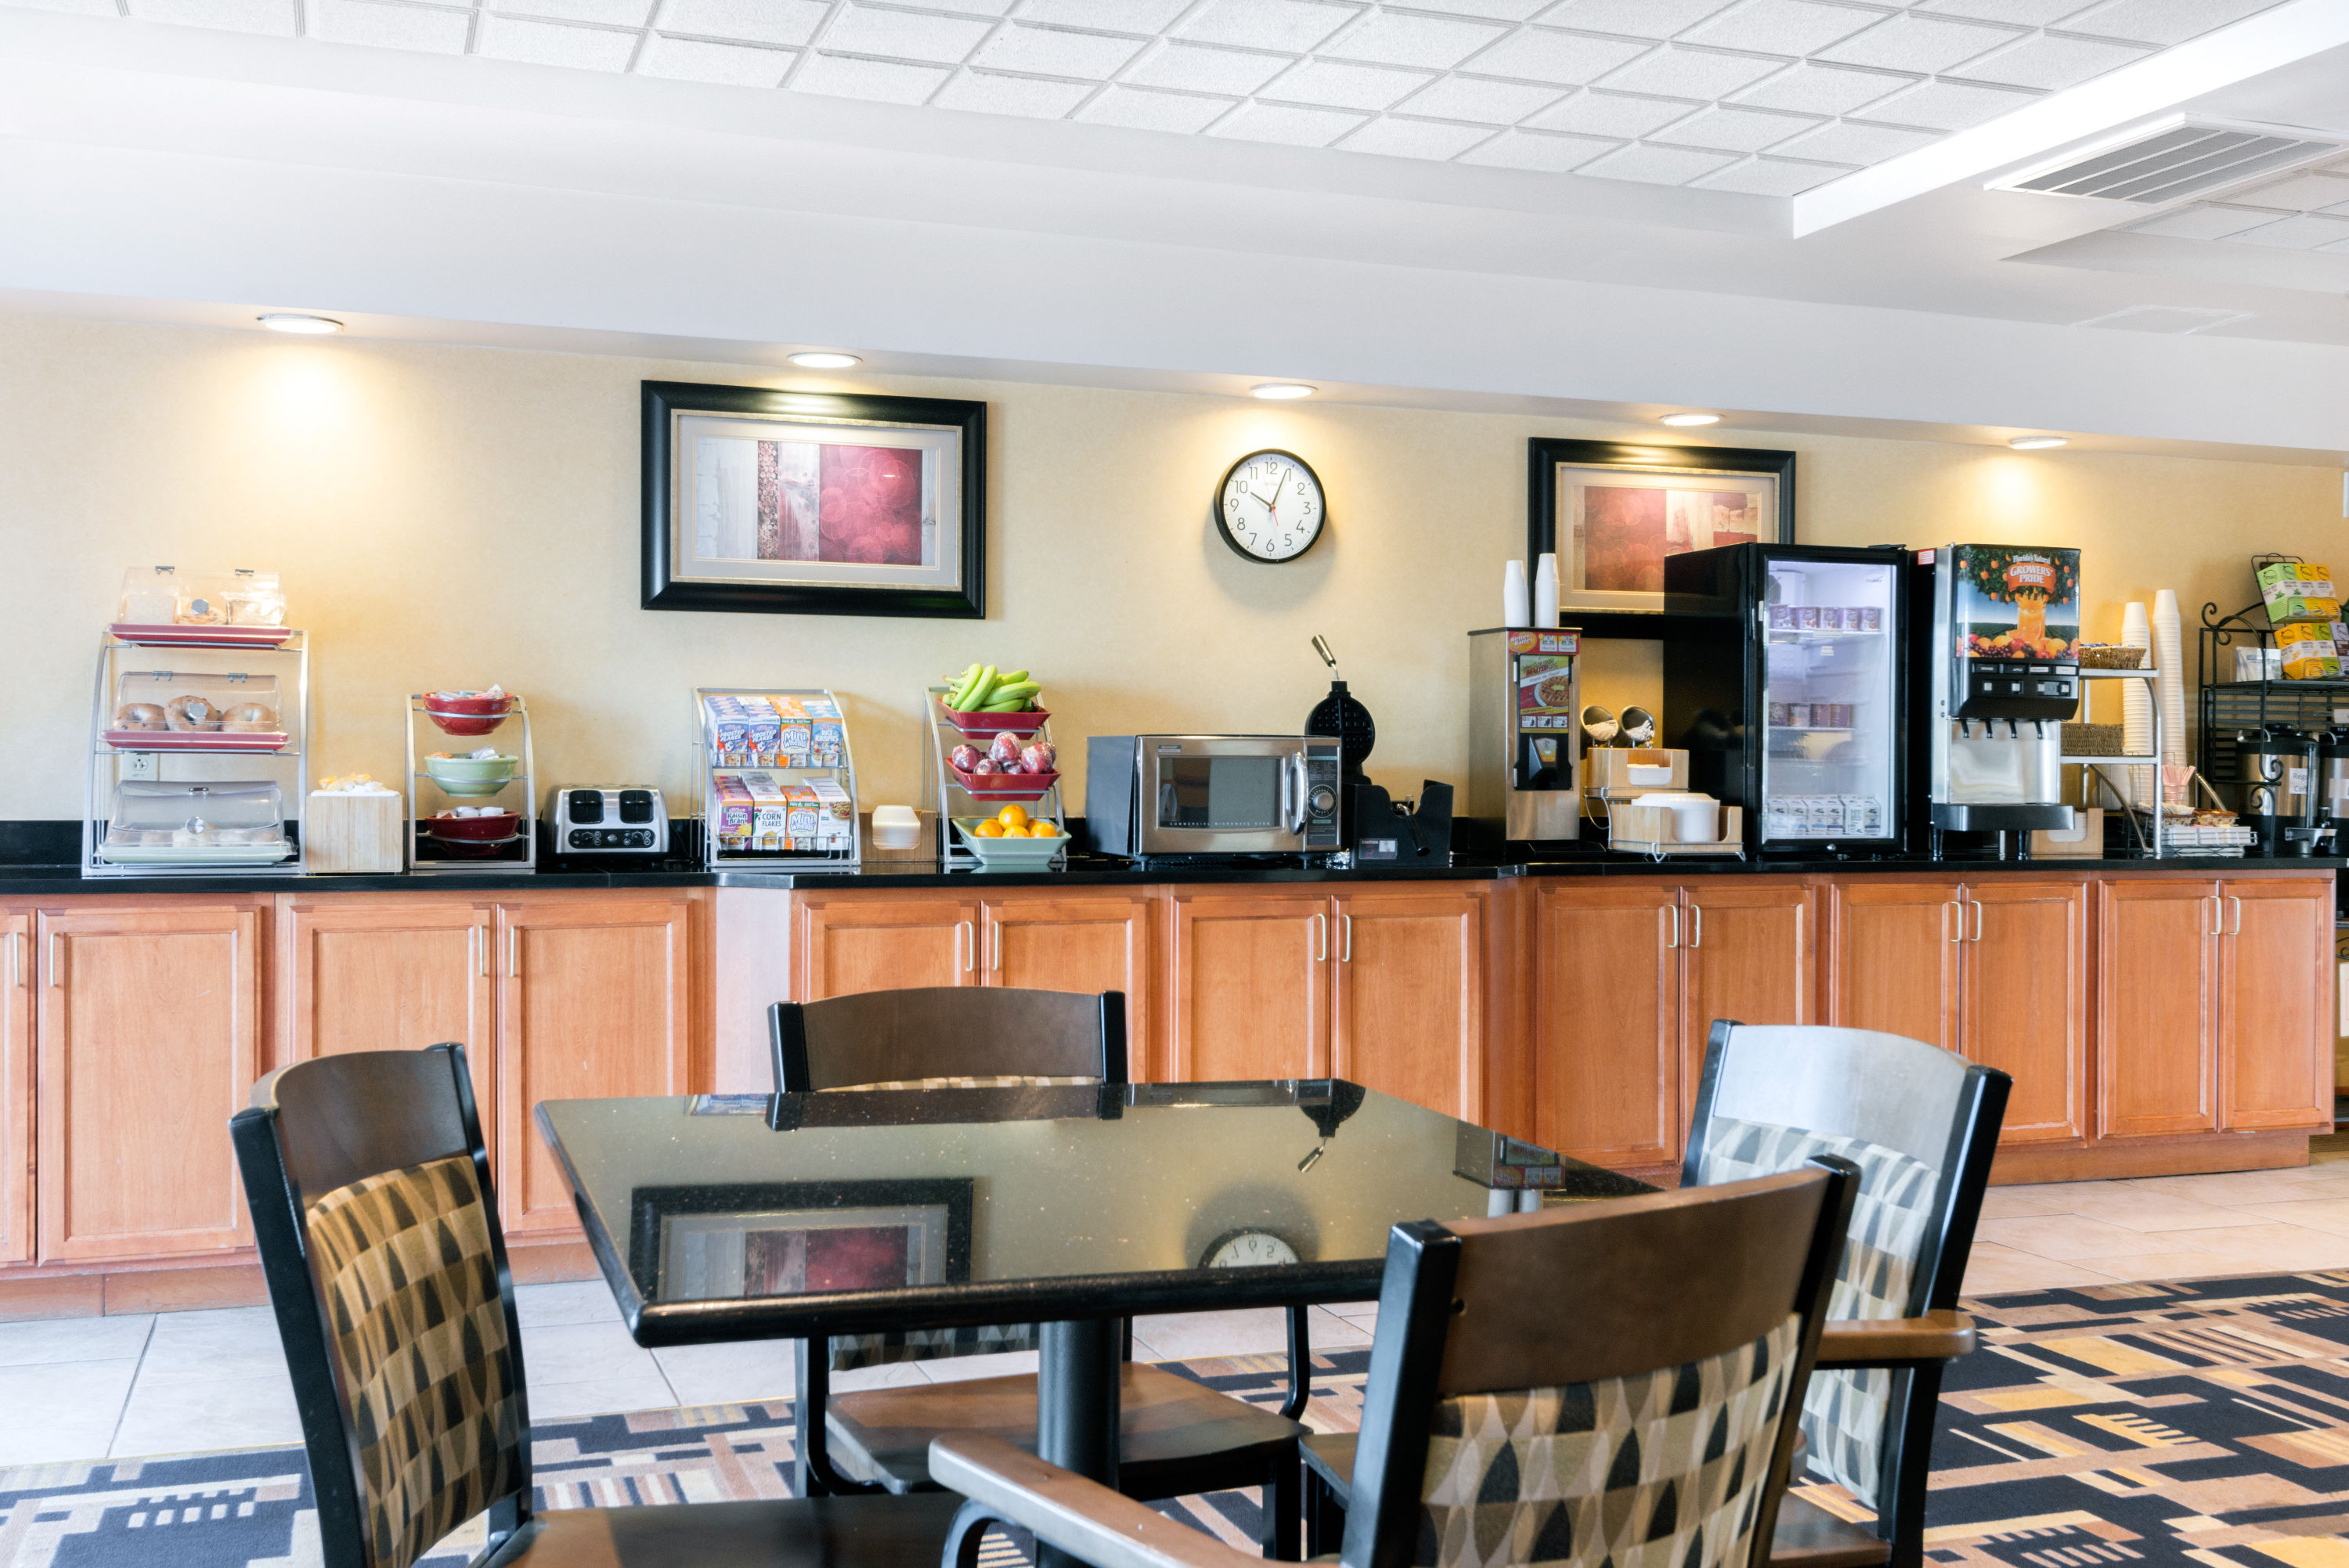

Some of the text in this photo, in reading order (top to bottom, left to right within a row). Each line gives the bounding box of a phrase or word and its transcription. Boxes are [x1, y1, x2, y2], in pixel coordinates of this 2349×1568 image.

[1249, 467, 1257, 480] 11
[1265, 462, 1278, 474] 12
[1235, 481, 1248, 493] 10
[1297, 482, 1305, 495] 2
[1230, 499, 1239, 512] 9
[1303, 502, 1311, 514] 3
[1237, 517, 1245, 530] 8
[1296, 520, 1305, 533] 4
[1249, 533, 1257, 546] 7
[1266, 539, 1275, 552] 6
[1284, 534, 1292, 546] 5
[2019, 575, 2044, 584] PRIDE
[752, 734, 773, 743] FLAKES
[783, 739, 806, 748] Wheats
